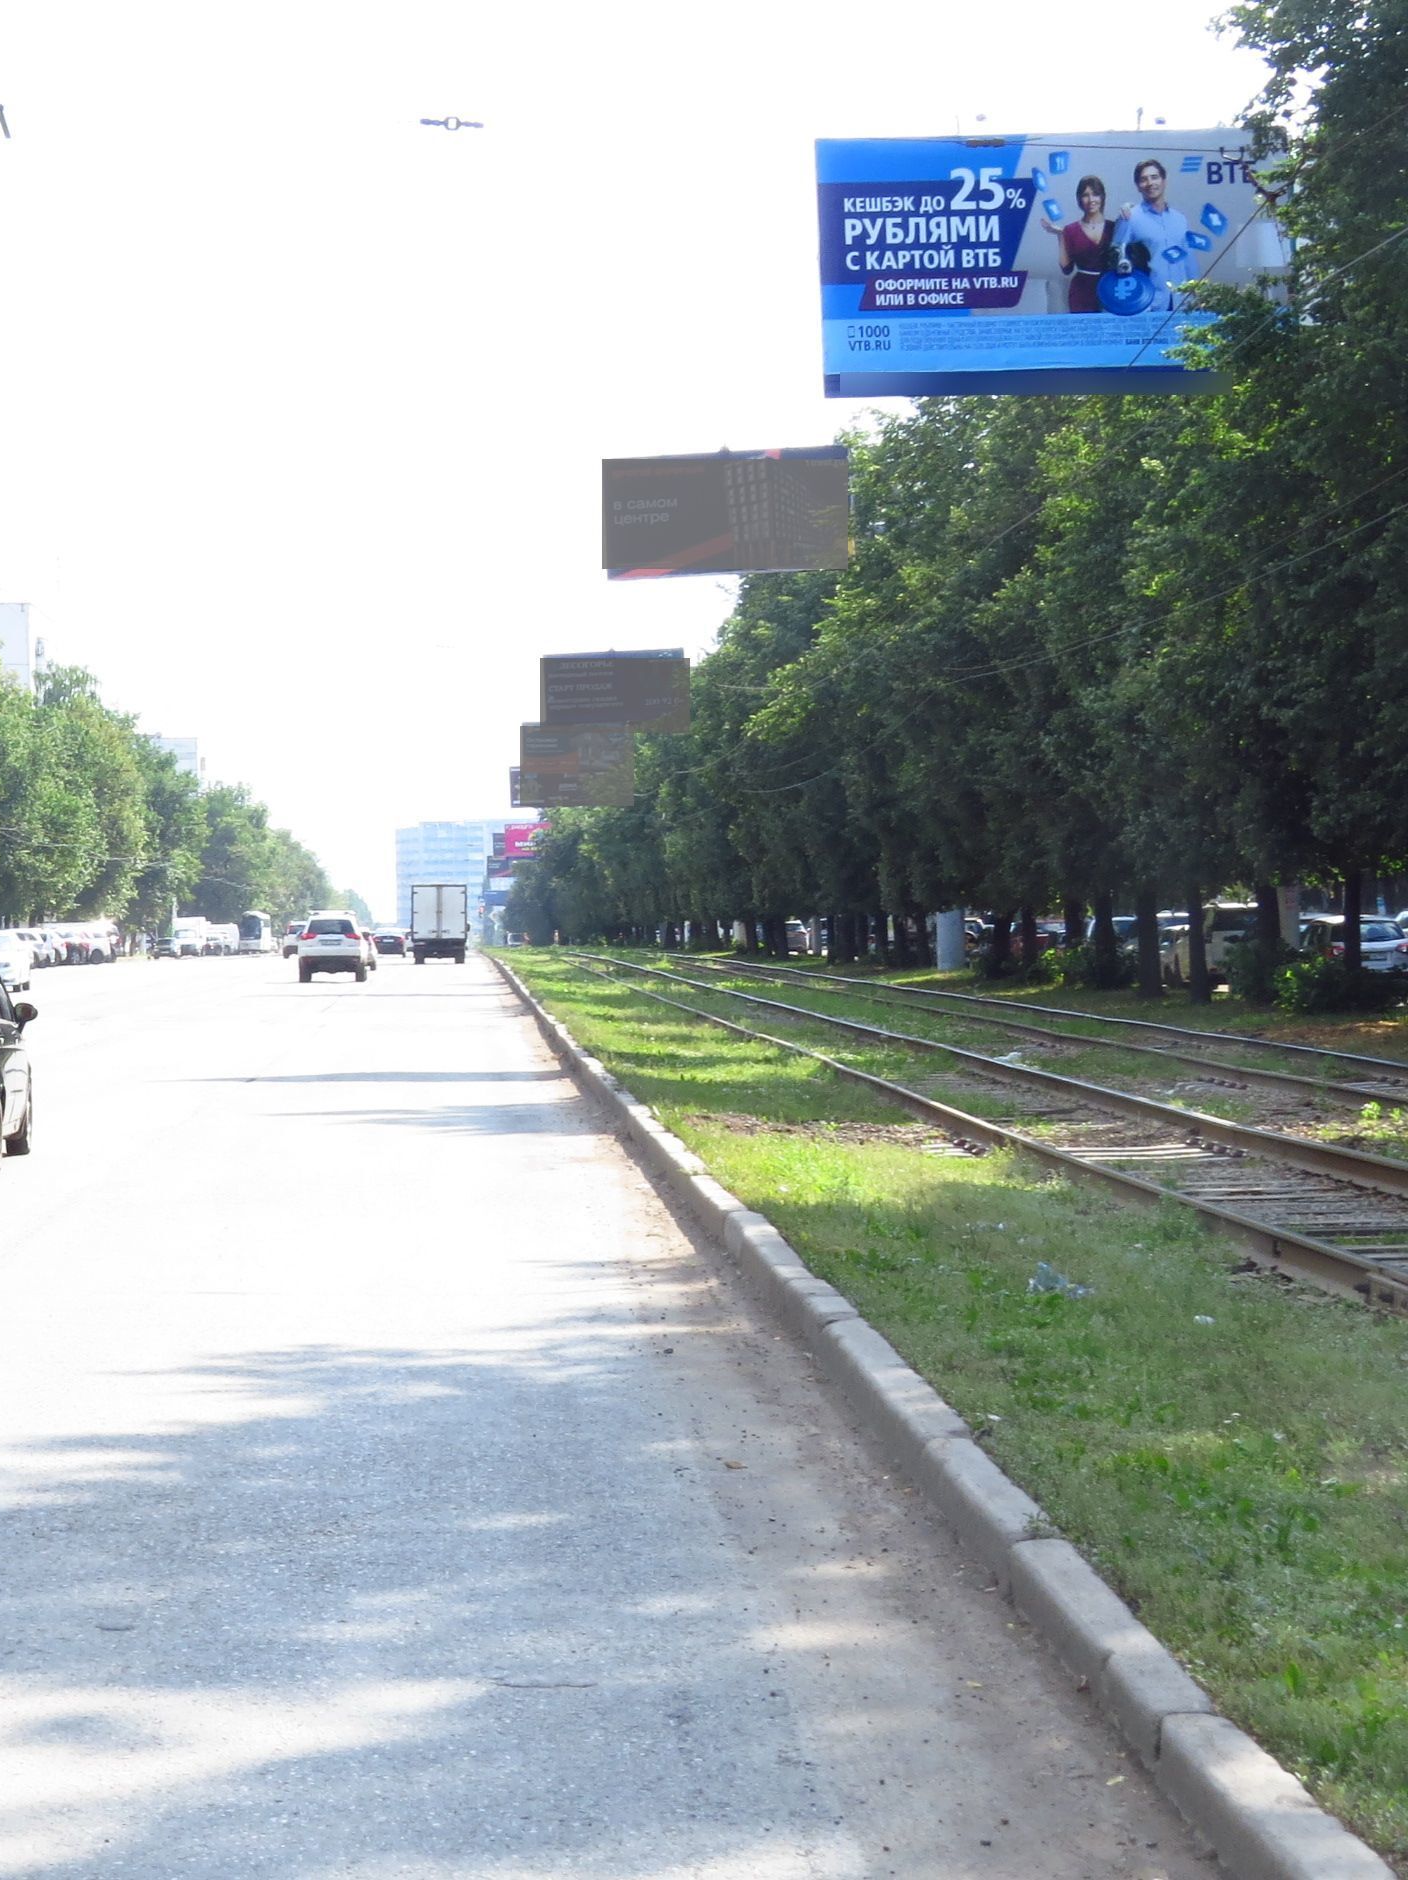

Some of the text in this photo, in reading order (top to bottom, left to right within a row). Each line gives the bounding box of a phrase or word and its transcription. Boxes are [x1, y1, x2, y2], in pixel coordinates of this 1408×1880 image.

[843, 167, 1027, 214] КЕШБЭК ДО 25%
[844, 215, 1000, 245] РУБЛЯМИ
[845, 245, 1002, 271] С КАРТОЙ ВТБ
[875, 276, 1018, 292] ОФОРМИТЕ НА VTB.RU
[875, 292, 964, 306] ИЛИ В ОФИСЕ
[858, 325, 890, 338] 1000
[848, 339, 891, 352] VTB.RU
